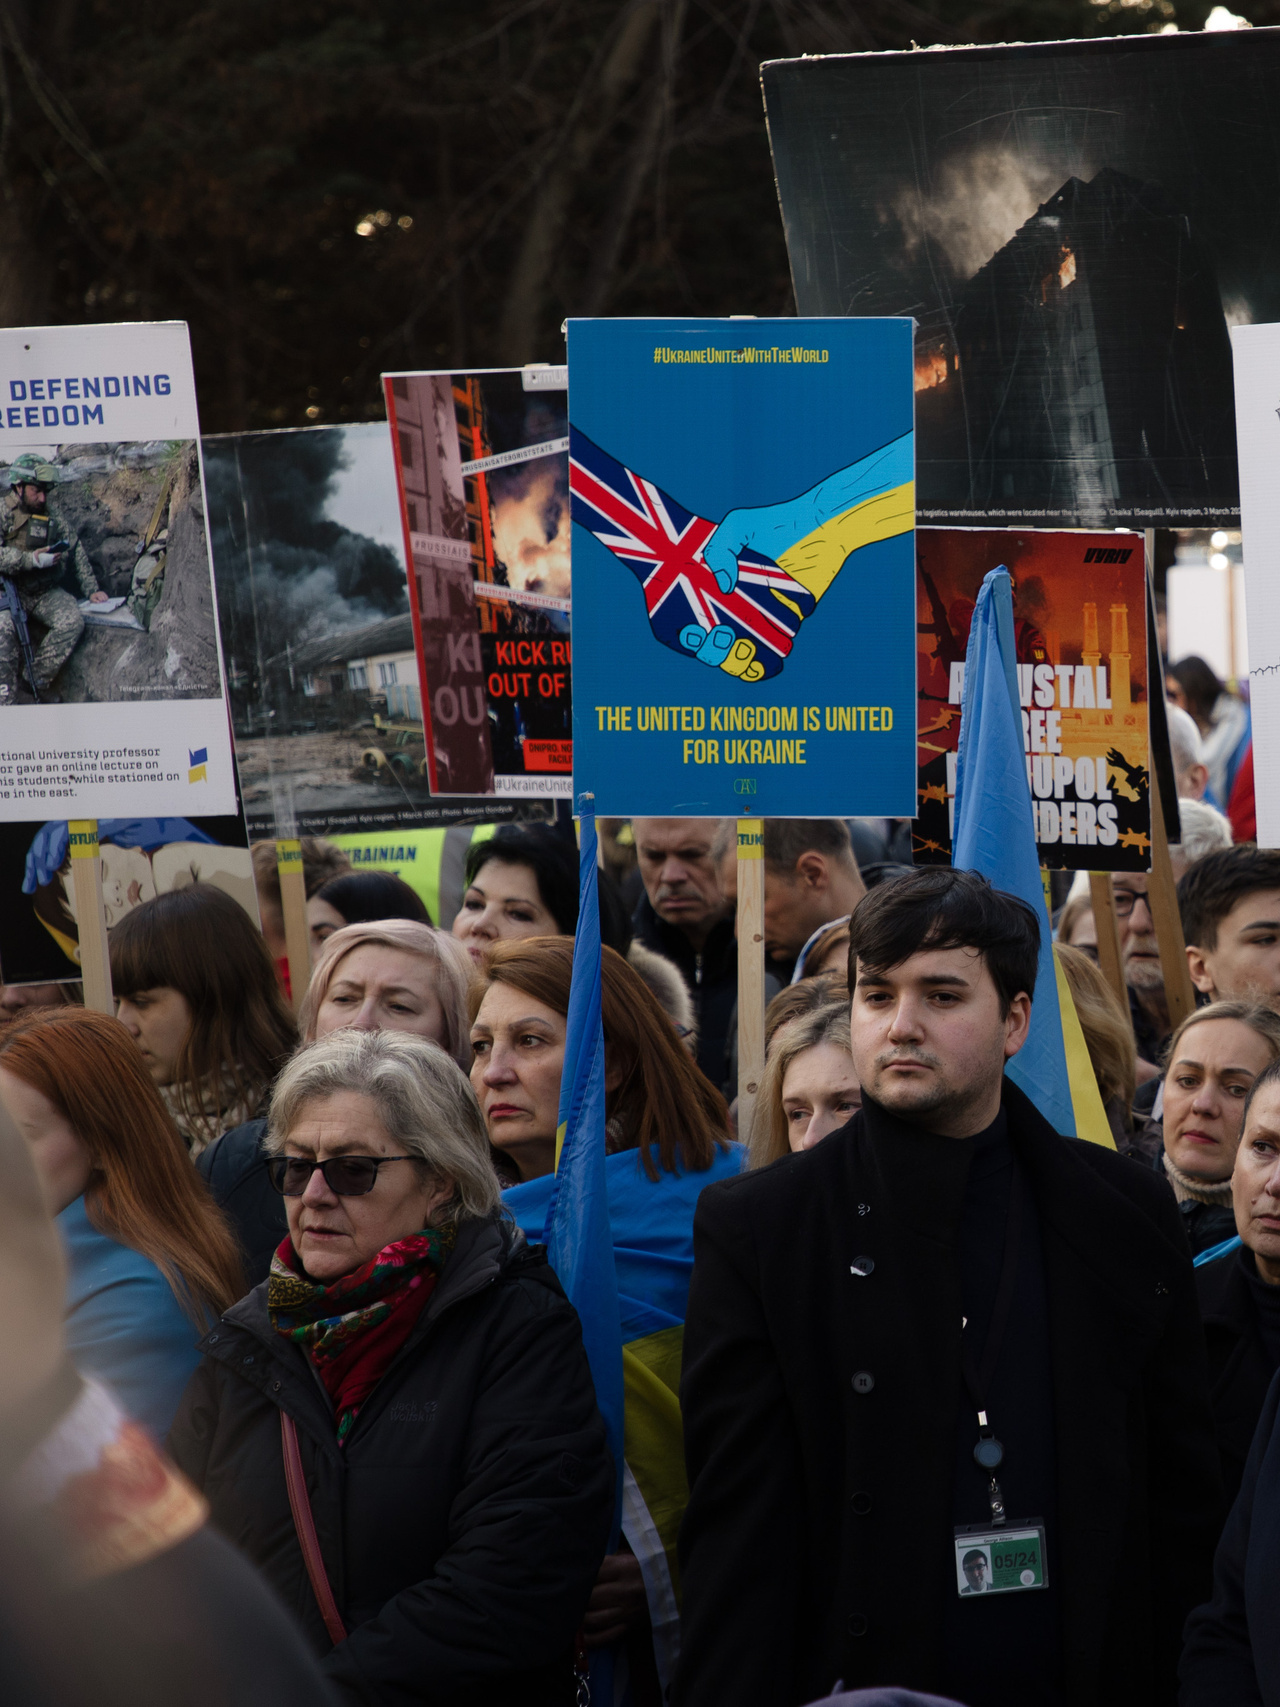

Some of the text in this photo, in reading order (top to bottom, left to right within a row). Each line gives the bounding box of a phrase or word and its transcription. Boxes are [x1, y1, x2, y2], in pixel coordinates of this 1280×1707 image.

[10, 374, 171, 401] DEFENDING
[923, 509, 948, 518] logistics
[950, 509, 988, 518] warehouses,
[988, 509, 1006, 517] which
[1023, 509, 1046, 517] located
[1180, 506, 1203, 517] region,
[1209, 506, 1230, 515] March
[496, 641, 547, 666] KICK
[488, 673, 566, 698] OUT OF
[595, 706, 893, 731] THE UNITED KINGDOM IS UNITED
[38, 749, 100, 761] University
[102, 748, 160, 760] professor
[683, 739, 806, 764] FOR UKRAINE
[16, 764, 42, 776] gave
[46, 763, 58, 773] an
[61, 762, 97, 772] online
[100, 760, 142, 771] lecture
[145, 760, 159, 770] on
[17, 775, 71, 787] students,
[74, 774, 104, 784] while
[108, 772, 163, 783] stationed
[167, 772, 180, 782] on
[13, 788, 25, 799] in
[28, 788, 46, 798] the
[49, 788, 78, 798] east.
[344, 846, 417, 863] RAINIAN
[994, 1551, 1037, 1569] 05/24
